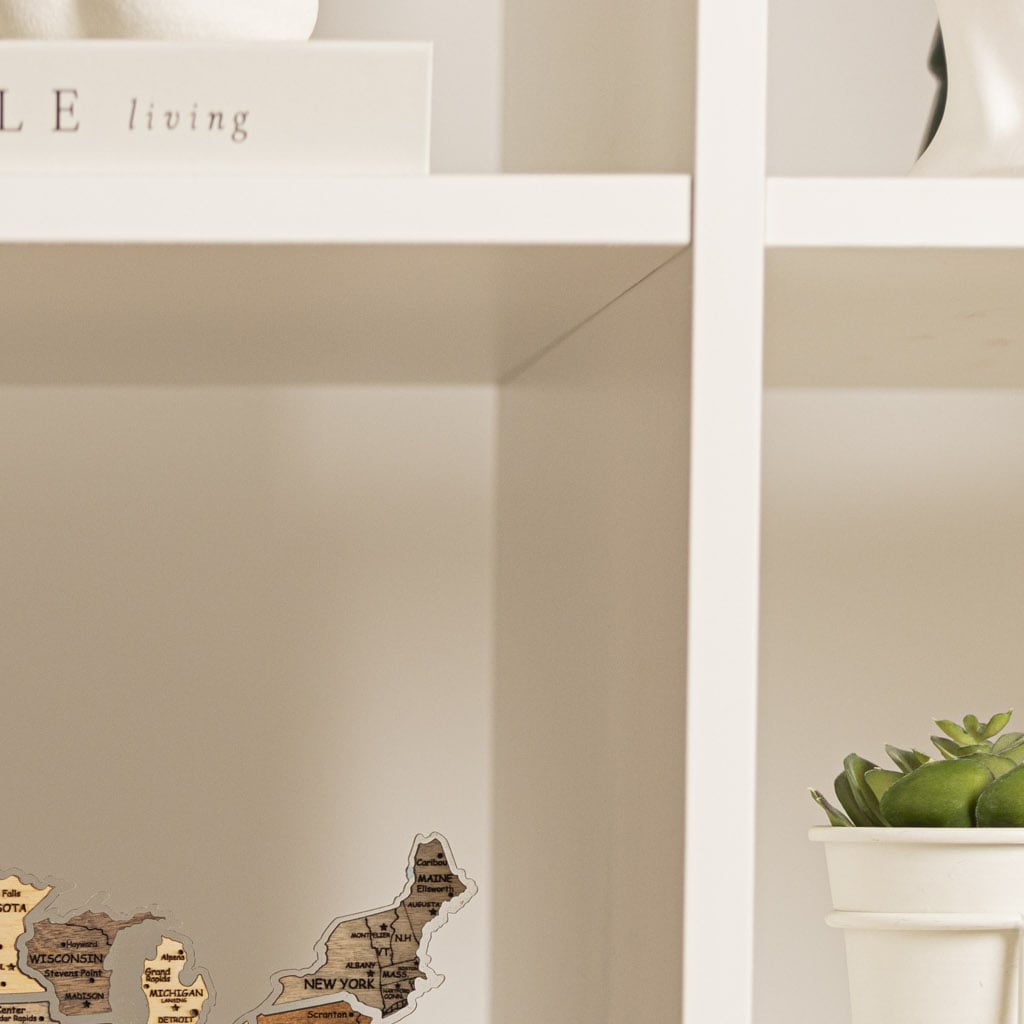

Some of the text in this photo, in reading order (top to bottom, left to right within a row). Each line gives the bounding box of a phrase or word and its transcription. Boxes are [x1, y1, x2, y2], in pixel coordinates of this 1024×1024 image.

[128, 98, 249, 143] living
[418, 875, 453, 883] MAINE
[30, 954, 103, 964] WISCONSIN
[145, 968, 170, 976] Grand
[304, 979, 375, 990] NEW YORK
[150, 989, 203, 997] MICHIGAN
